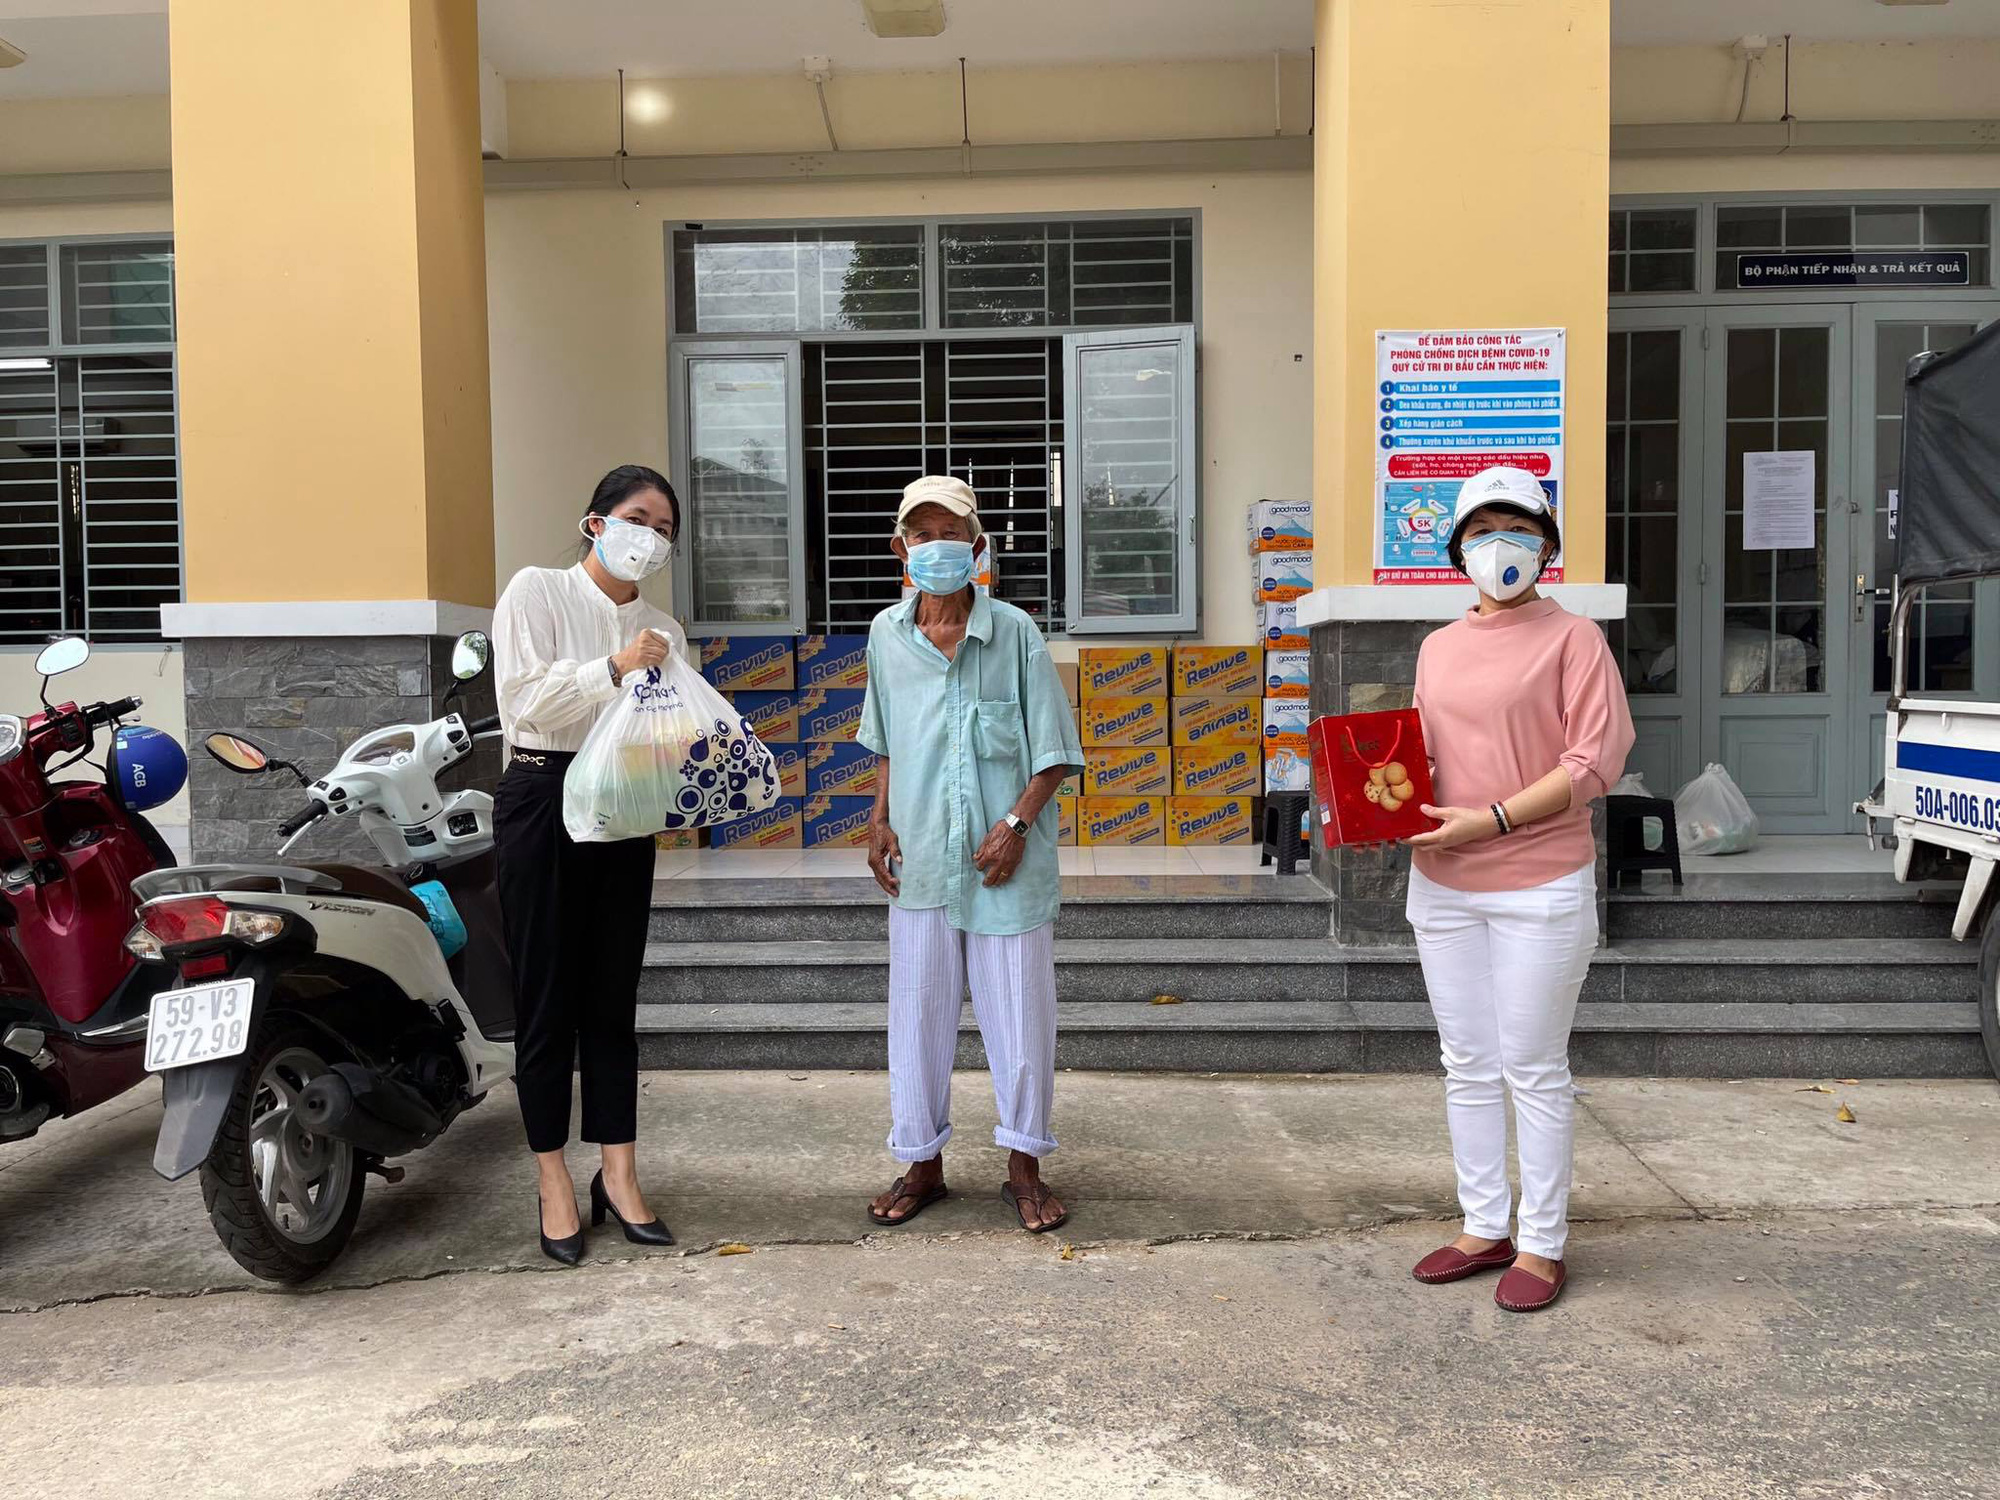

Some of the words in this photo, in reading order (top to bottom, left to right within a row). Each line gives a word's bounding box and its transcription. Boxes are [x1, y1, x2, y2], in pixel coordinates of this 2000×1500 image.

[1744, 264, 1762, 277] BỘ
[1766, 263, 1798, 277] PHẬN
[1801, 262, 1830, 275] TIẾP
[1833, 262, 1866, 276] NHẬN
[1869, 264, 1878, 274] &
[1882, 261, 1906, 273] TRẢ
[1909, 260, 1933, 273] KẾT
[1936, 260, 1960, 274] QUẢ
[1424, 348, 1455, 359] CHỐNG
[1458, 349, 1479, 361] DỊCH
[1482, 348, 1506, 360] BỆNH
[1509, 348, 1550, 358] COVID-19
[1432, 334, 1453, 346] ĐẢM
[1456, 334, 1474, 346] BẢO
[1477, 334, 1502, 345] CÔNG
[1504, 334, 1522, 344] TÁC
[1428, 362, 1441, 372] TRI
[1386, 401, 1390, 409] 2
[1399, 384, 1420, 392] Khai
[1386, 420, 1390, 428] 3
[716, 644, 785, 686] Revive
[812, 649, 867, 684] Reviv
[1093, 652, 1152, 688] Revive
[1187, 651, 1247, 686] Revive
[746, 698, 790, 724] vive
[1095, 703, 1154, 738] Revive
[1188, 706, 1249, 741] Revive
[132, 763, 146, 788] ACB
[1097, 752, 1156, 785] Revive
[1186, 752, 1246, 787] Revive
[726, 804, 793, 844] Revive
[1091, 802, 1150, 836] Revive
[1180, 802, 1240, 836] Revive
[166, 988, 238, 1028] 59-V3
[153, 1020, 242, 1064] 272.98
